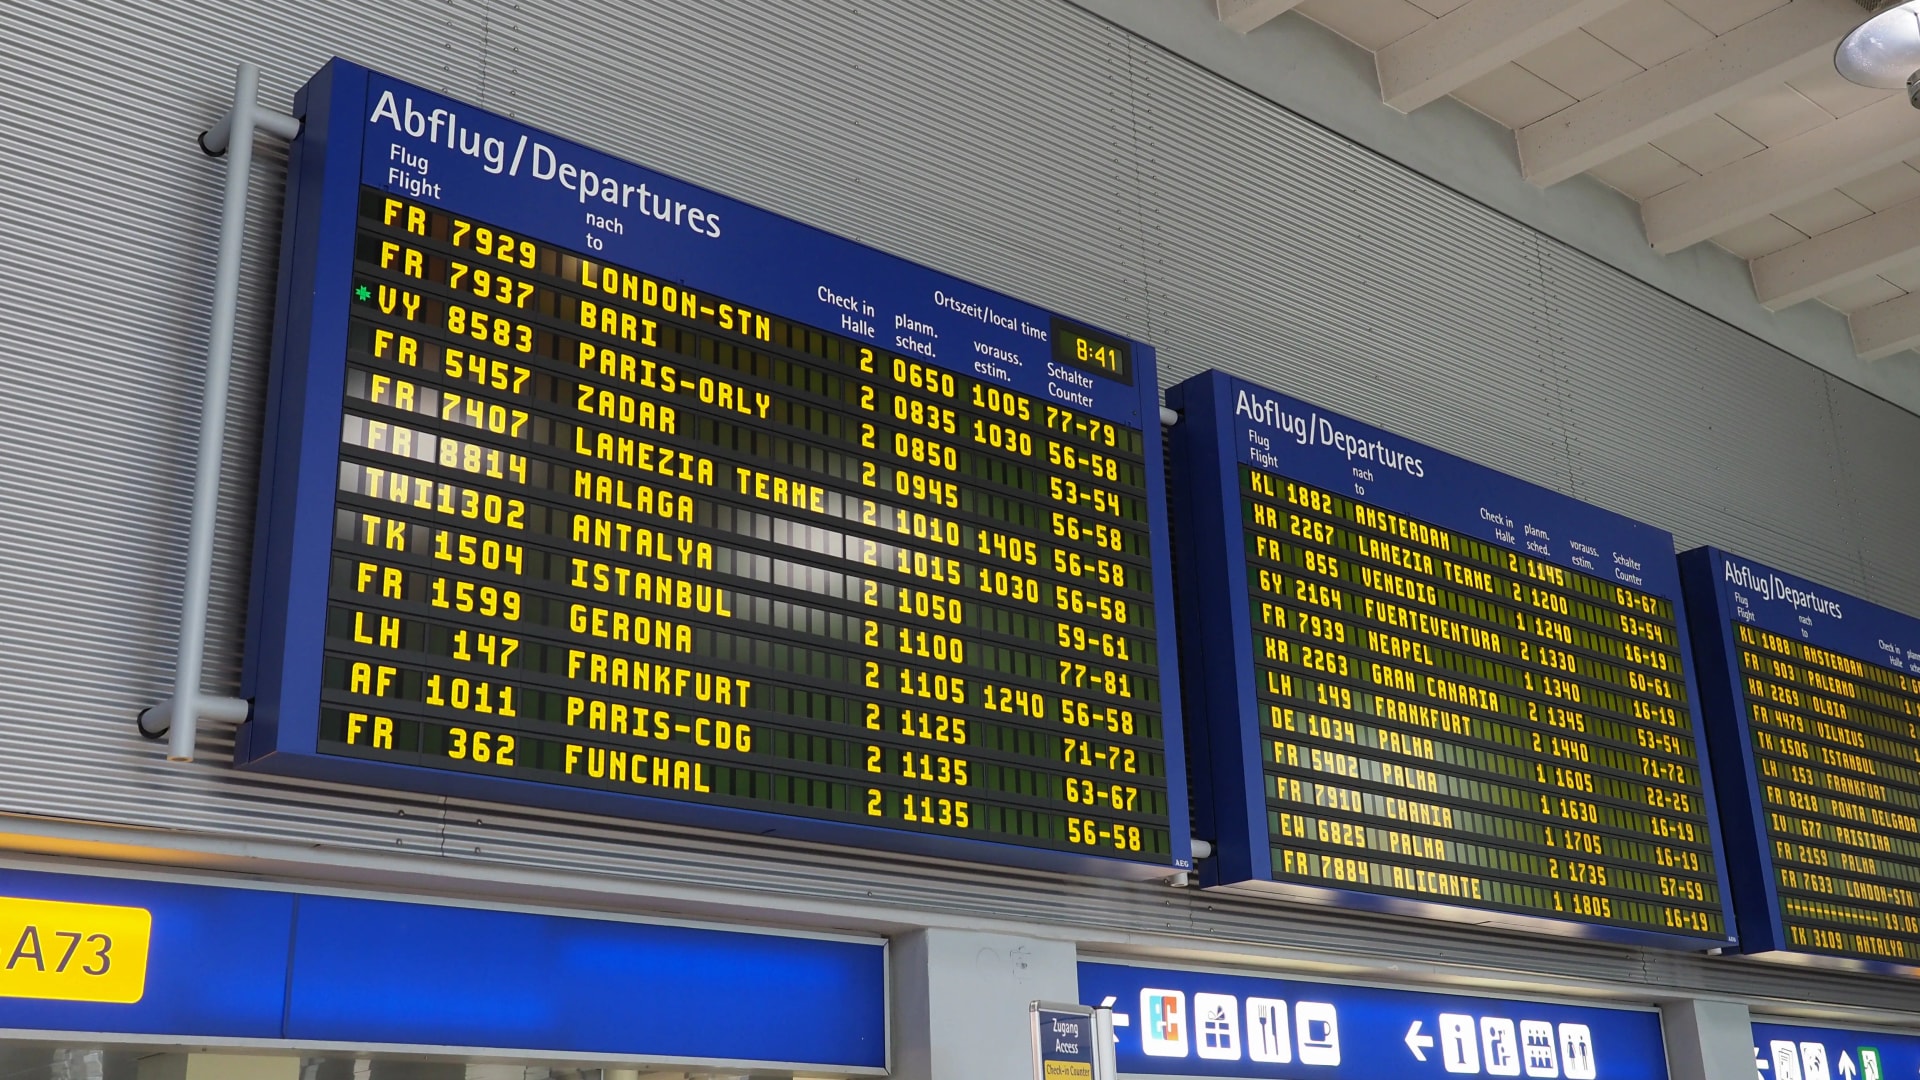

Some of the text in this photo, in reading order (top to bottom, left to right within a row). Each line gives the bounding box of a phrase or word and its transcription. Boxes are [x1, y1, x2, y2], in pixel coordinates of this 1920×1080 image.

[370, 91, 720, 237] Abflug/Departures
[391, 144, 428, 175] Flug
[389, 168, 441, 199] Flight
[587, 213, 623, 235] nach
[586, 233, 603, 250] to
[818, 286, 874, 317] Check in
[935, 291, 1046, 341] Ortszeit/local time
[384, 198, 1115, 447] FR 7929 LONDON-STN 2 0650 1005 77-79
[842, 314, 874, 338] Halle
[896, 314, 937, 338] planm.
[896, 336, 935, 357] sched.
[974, 341, 1022, 366] vorauss.
[1076, 338, 1116, 370] 8:41
[975, 362, 1010, 381] estim.
[1048, 362, 1093, 389] Schalter
[378, 284, 1120, 517] VY 8583 PARIS-ORLY 2 0850 53-54
[1049, 382, 1093, 407] Counter
[1236, 390, 1423, 477] Abflug/Departures
[1249, 429, 1269, 450] Flug
[1251, 447, 1278, 467] Flight
[371, 374, 1124, 587] FR 7407 LAMEZIA TERME 2 1010 1405 56-58
[1353, 468, 1373, 481] nach
[1355, 483, 1364, 495] to
[1480, 508, 1513, 528] Check in
[1525, 524, 1549, 540] planm.
[1251, 471, 1657, 614] KL 1882 AMSTERDAM 2 1145 63-67
[1496, 528, 1515, 544] Halle
[1527, 541, 1550, 555] sched.
[1570, 541, 1599, 556] vorauss.
[1572, 556, 1594, 570] estim.
[1613, 552, 1640, 570] Schalter
[1615, 568, 1642, 585] Counter
[1290, 514, 1334, 545] 2267
[1358, 535, 1433, 576] LAMEZIA
[1443, 561, 1493, 593] TERME
[1513, 582, 1522, 602] 2
[1531, 588, 1568, 615] 1200
[1620, 614, 1663, 643] 53-54
[1726, 560, 1842, 619] Abflug/Departures
[363, 514, 1131, 698] TK 1504 ISTANBUL 2 1100 77-81
[357, 562, 1134, 735] FR 1599 GERONA 2 1105 1240 56-58
[1259, 569, 1672, 699] 6Y 2164 FUERTEVENTURA 2 1330 60-61
[1262, 602, 1676, 727] FR 7939 NEAPEL 1 1340 16-19
[1739, 626, 1863, 677] KL 1888 AMSTERDAM
[1743, 651, 1856, 698] FR 903 PALERMO
[354, 611, 1136, 774] LH 147 FRANKFURT 2 1125 71-72
[1770, 684, 1800, 707] 2269
[1812, 696, 1847, 719] OLBIA
[350, 662, 1137, 811] AF 1011 PARIS-CDG 2 1135 63-67
[1268, 671, 1685, 784] LH 149 FRANKFURT 2 1440 71-72
[1753, 704, 1865, 748] FR 4479 VILNIUS
[1271, 706, 1690, 813] DE 1034 PALMA 1 1605 22-25
[1757, 731, 1876, 775] TK 1506 ISTANBUL
[1762, 758, 1886, 801] LH 153 FRANKFURT
[1767, 785, 1917, 832] FR 8218 PONTA DELGADA
[1772, 813, 1890, 851] IV 677 PRISTINA
[5, 925, 112, 976] A73
[1053, 1018, 1078, 1037] Zugang
[1056, 1039, 1078, 1053] Access
[1046, 1064, 1090, 1077] Check-in Counter
